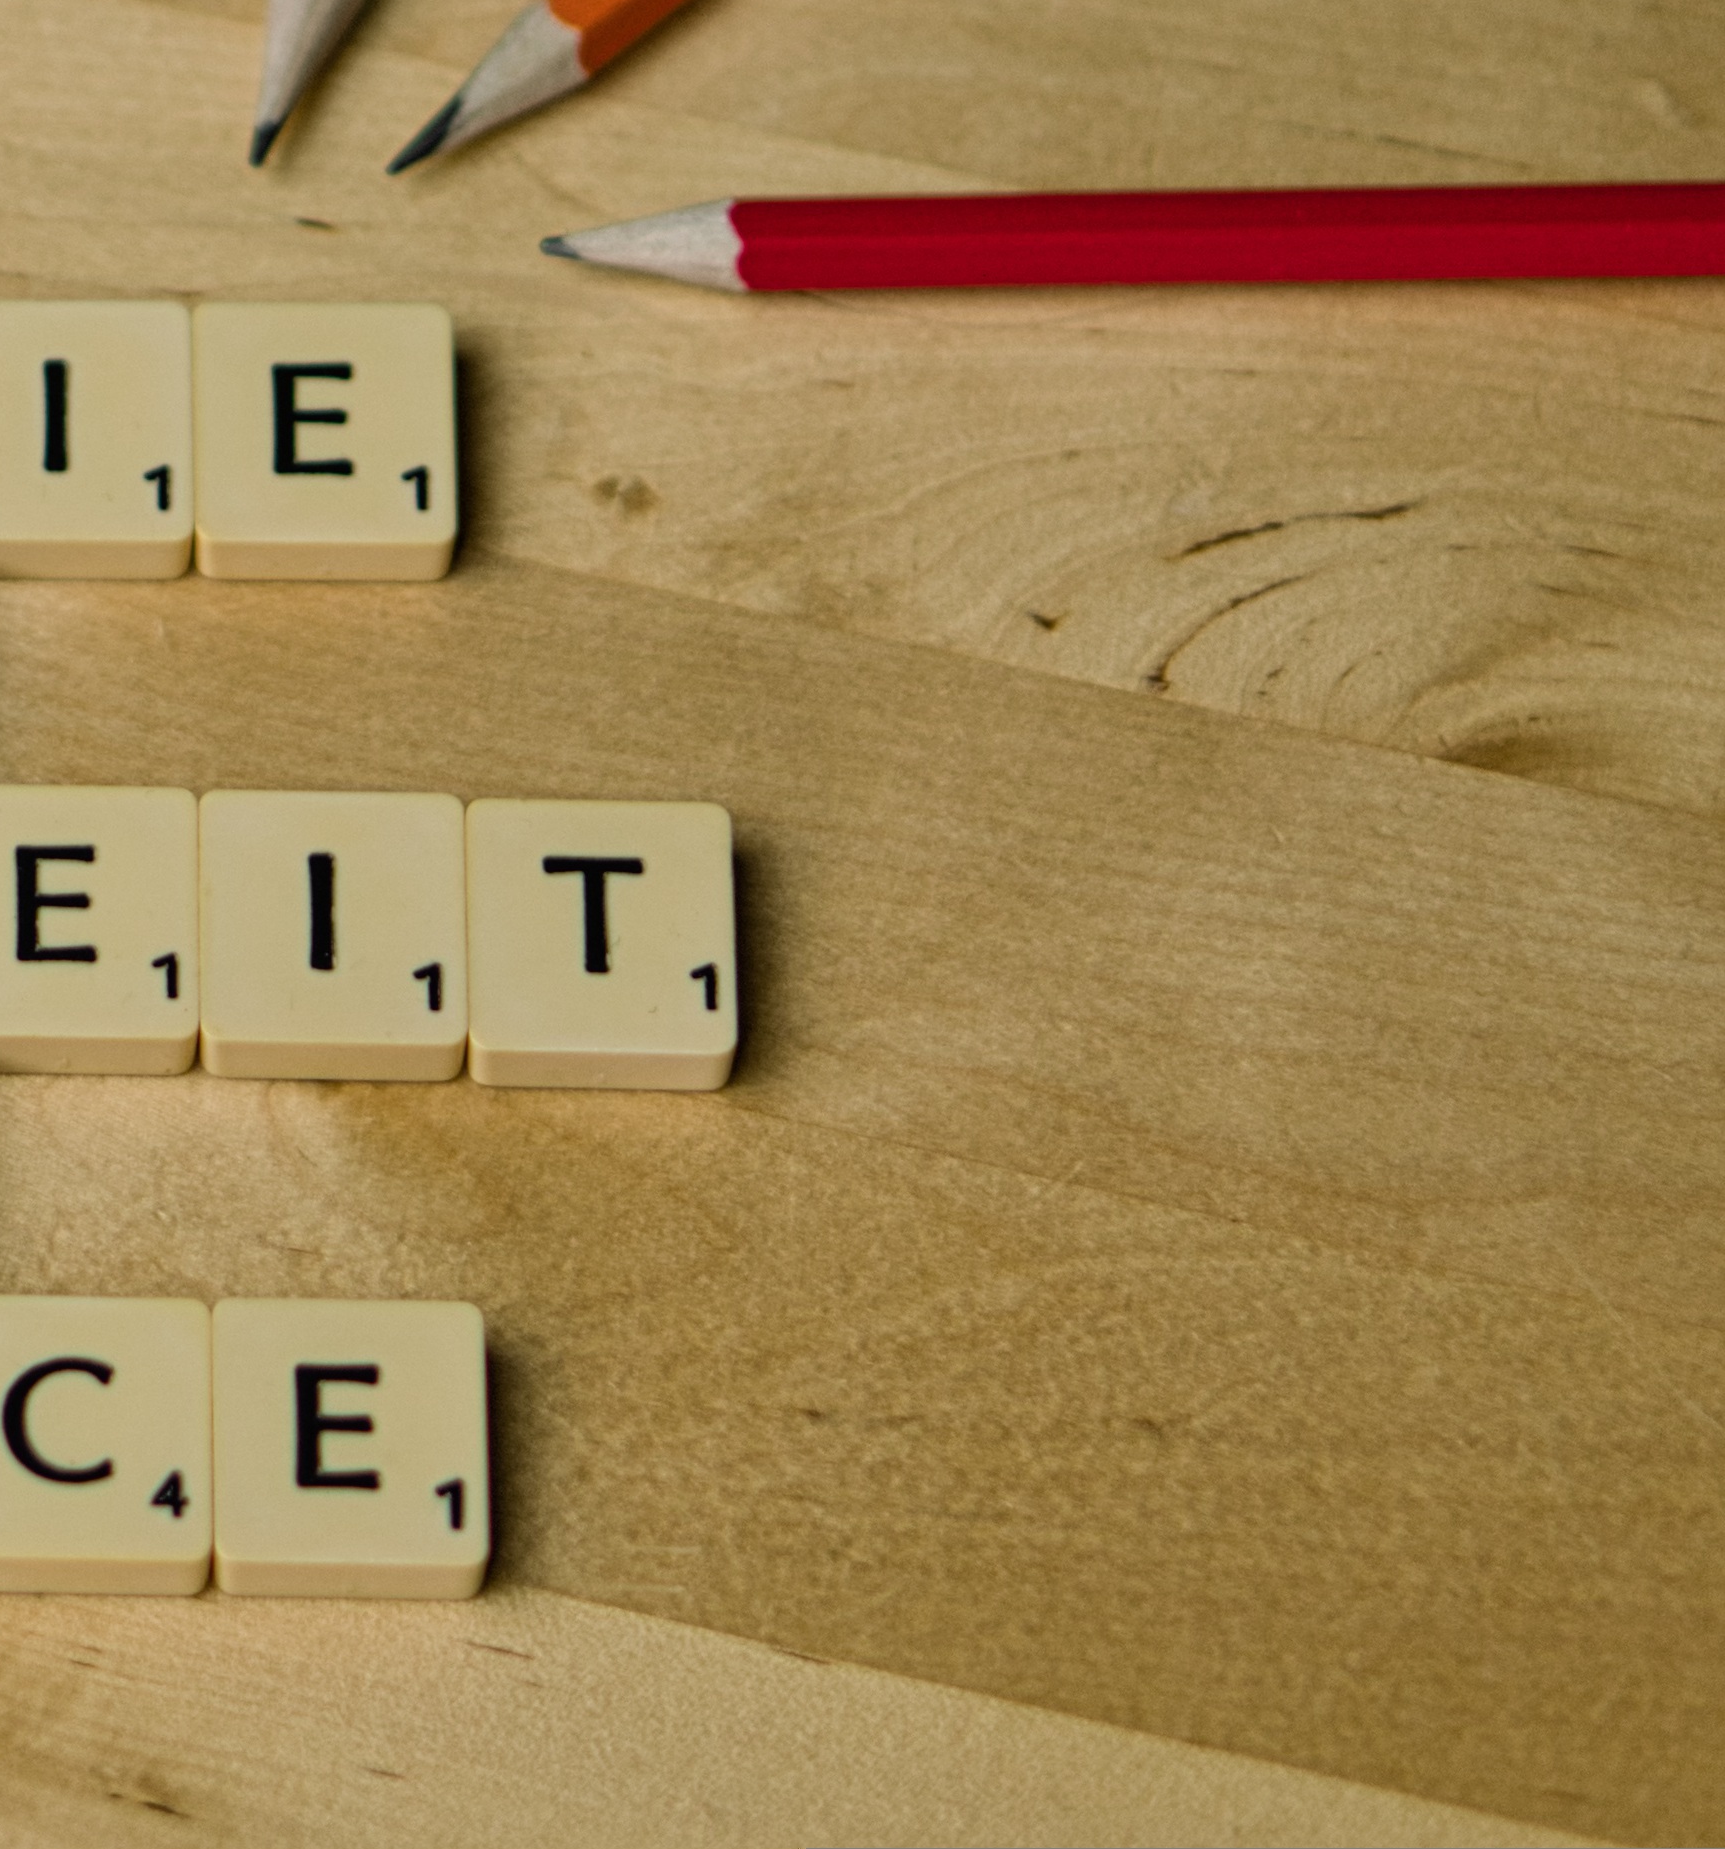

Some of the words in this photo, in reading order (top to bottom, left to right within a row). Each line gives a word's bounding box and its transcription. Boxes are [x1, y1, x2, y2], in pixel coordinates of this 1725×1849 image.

[144, 465, 171, 512] 1
[401, 466, 429, 512] 1
[151, 952, 179, 1000] 1
[412, 962, 443, 1012] 1
[689, 963, 718, 1011] 1
[151, 1471, 189, 1518] 4
[435, 1479, 465, 1531] 1
